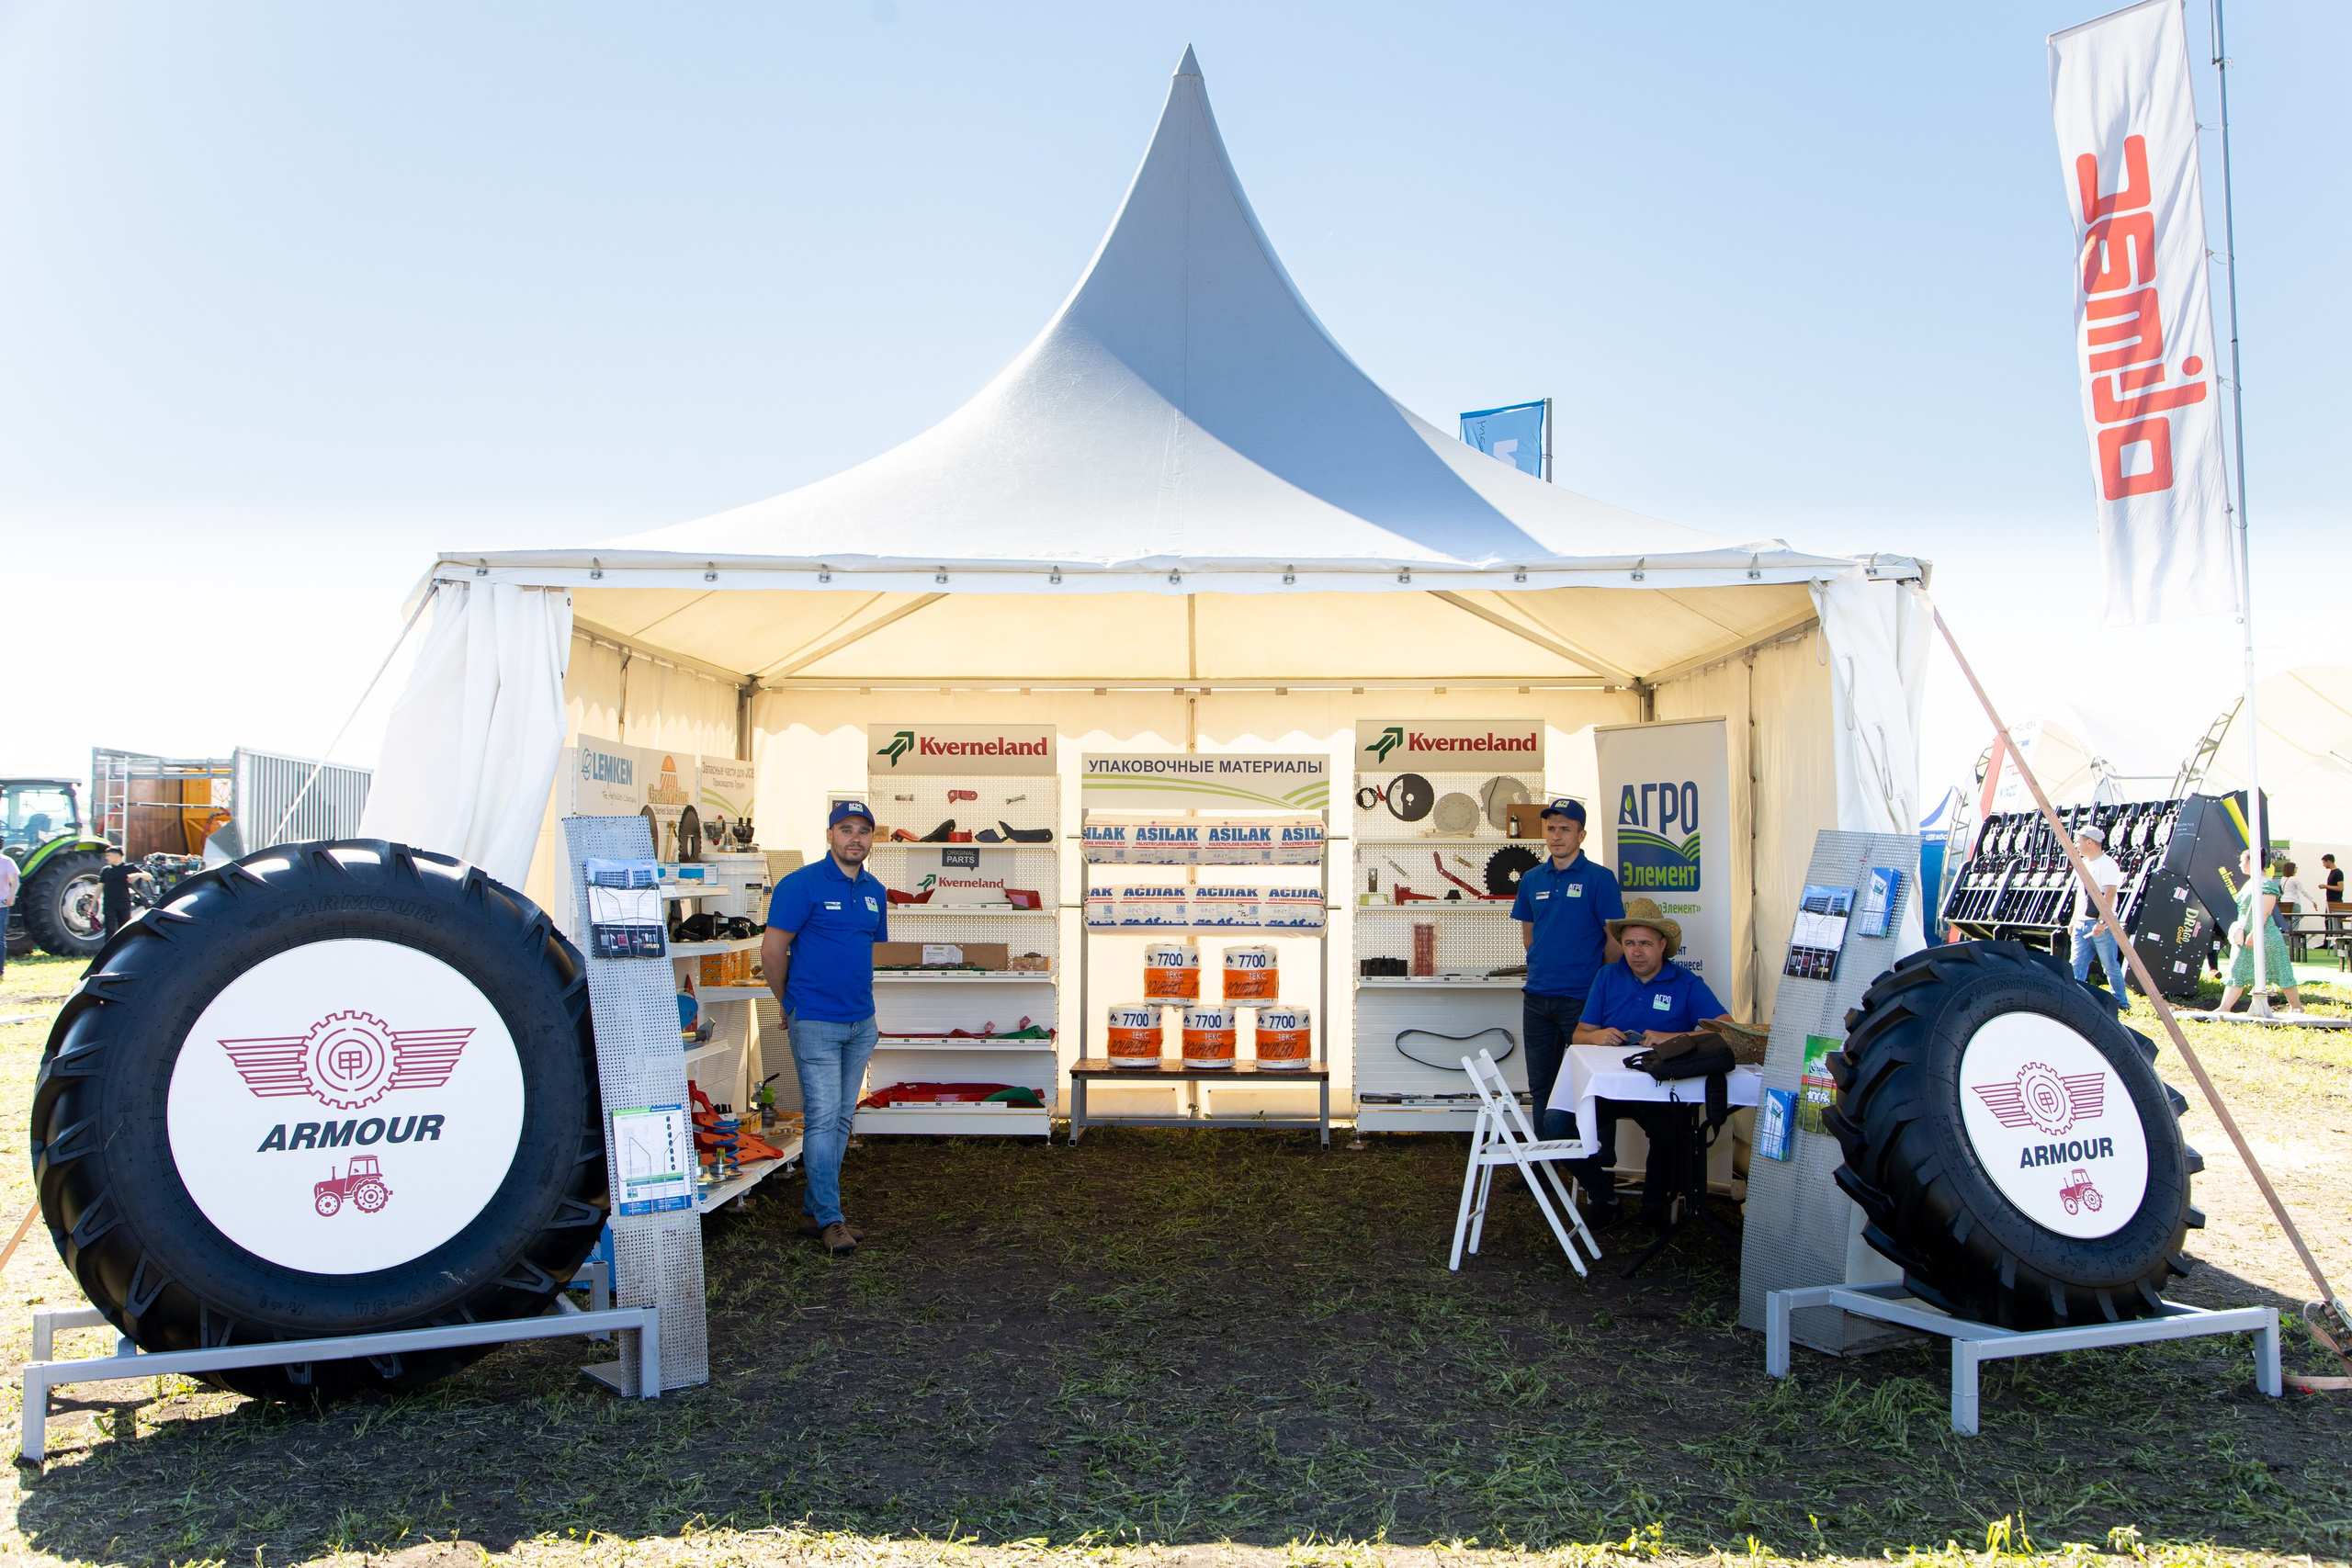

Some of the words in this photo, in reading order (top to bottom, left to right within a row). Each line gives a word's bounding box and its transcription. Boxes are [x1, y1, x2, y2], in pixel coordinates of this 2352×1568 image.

[920, 736, 1047, 756] Kverneland
[1408, 732, 1537, 751] Kverneland
[593, 751, 633, 787] LEMKEN
[702, 761, 724, 775] Запасные
[724, 766, 736, 776] части
[737, 769, 745, 778] для
[745, 767, 754, 779] JCB
[1089, 760, 1215, 773] УПАКОВОЧНЫЕ
[1218, 761, 1323, 774] МАТЕРИАЛЫ
[713, 777, 734, 788] Производство
[734, 780, 745, 790] Турция
[647, 783, 669, 804] Great
[1618, 781, 1699, 836] АГРО
[1136, 827, 1198, 841] ASILAK
[1208, 828, 1272, 841] ASILAK
[946, 855, 975, 863] PARTS
[1623, 862, 1697, 887] Элемент
[938, 876, 1004, 889] Kverneland
[294, 894, 438, 924] ARMOUR
[2182, 907, 2199, 942] DRAGO
[2176, 926, 2185, 944] Gold
[1158, 953, 1183, 966] 7700
[1238, 954, 1266, 968] 7700
[1166, 971, 1183, 979] ТЕКС
[1249, 972, 1267, 980] ТЕКС
[1975, 978, 2054, 1000] ARMOUR
[1655, 993, 1671, 1003] АГРО
[1123, 1013, 1148, 1027] 7700
[1195, 1014, 1222, 1028] 7700
[1269, 1015, 1295, 1029] 7700
[1132, 1031, 1149, 1039] ТЕКС
[1204, 1032, 1222, 1041] ТЕКС
[1278, 1032, 1296, 1041] ТЕКС
[257, 1114, 447, 1153] ARMOUR
[2019, 1136, 2115, 1169] ARMOUR
